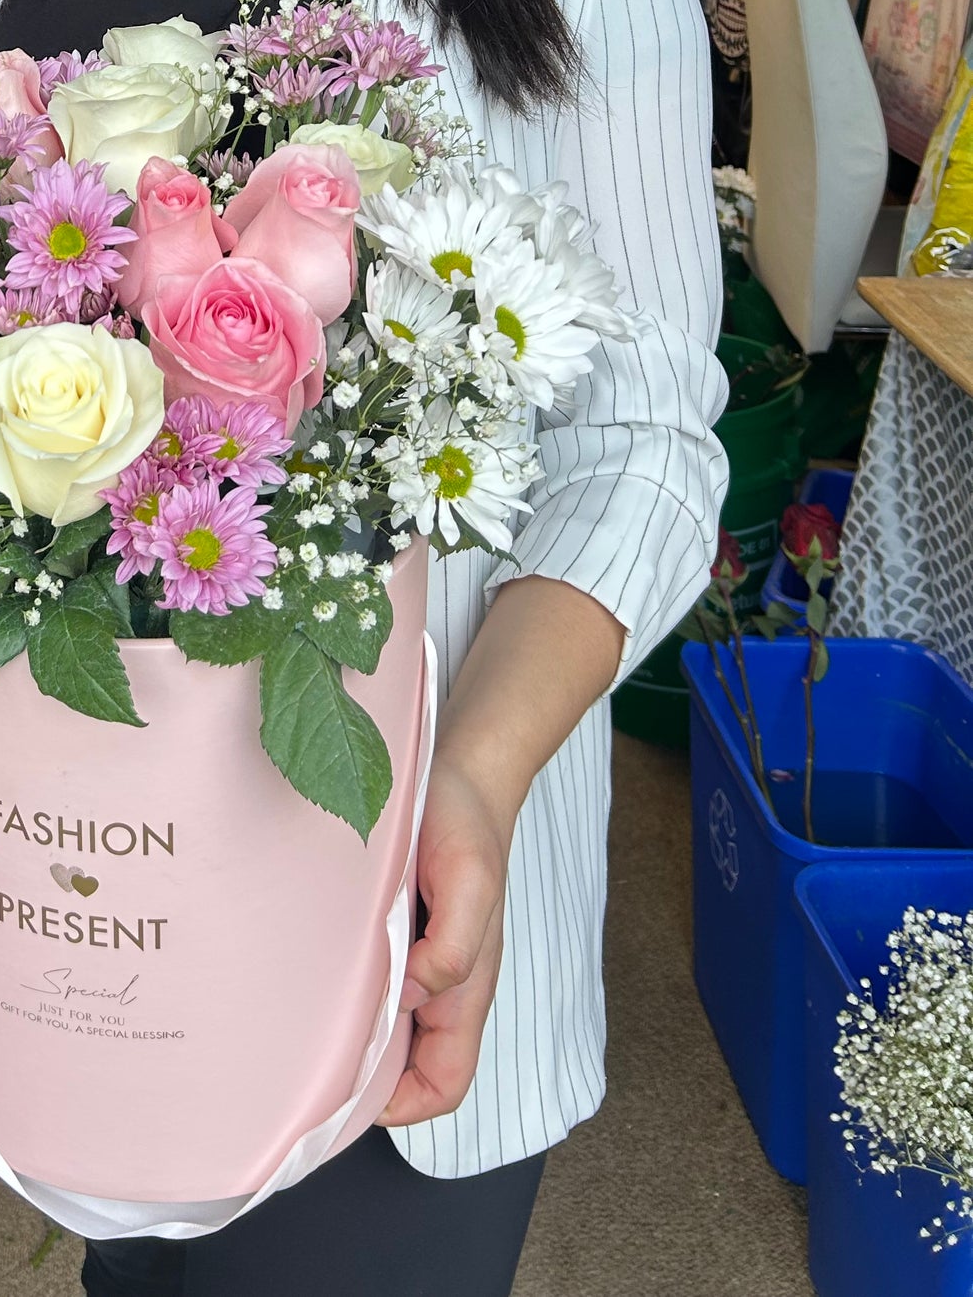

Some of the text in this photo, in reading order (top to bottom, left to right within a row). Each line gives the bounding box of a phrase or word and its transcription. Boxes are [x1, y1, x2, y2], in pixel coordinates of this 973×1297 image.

[20, 968, 139, 1005] Special
[0, 1001, 20, 1015] GIFT
[23, 1010, 43, 1023] FOR
[75, 1025, 84, 1034] A
[87, 1027, 129, 1039] SPECIAL
[132, 1030, 185, 1040] BLESSING
[39, 1002, 126, 1027] JUST FOR YOU
